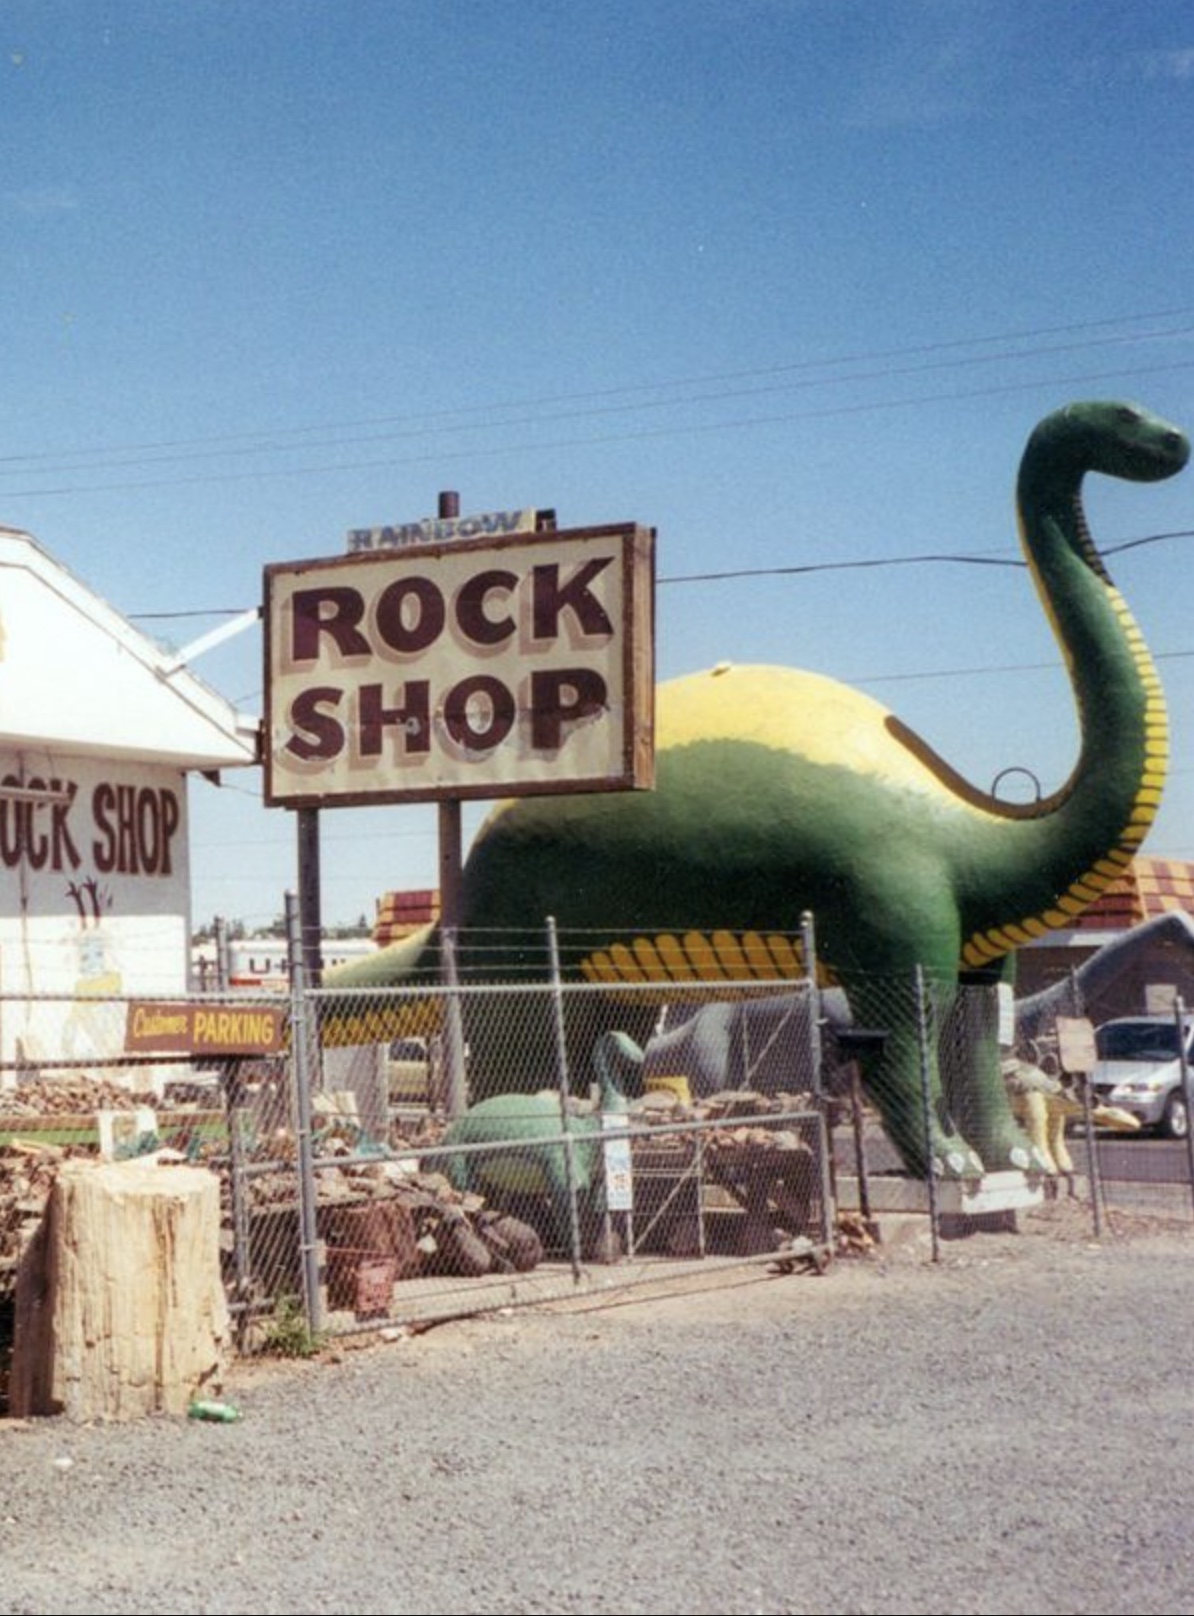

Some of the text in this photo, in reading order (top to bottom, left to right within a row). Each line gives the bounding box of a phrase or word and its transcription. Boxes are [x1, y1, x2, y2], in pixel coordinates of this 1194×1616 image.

[290, 557, 616, 663] ROCK
[284, 667, 611, 764] SHOP
[92, 782, 180, 875] SHOP
[193, 1012, 274, 1045] PARKING
